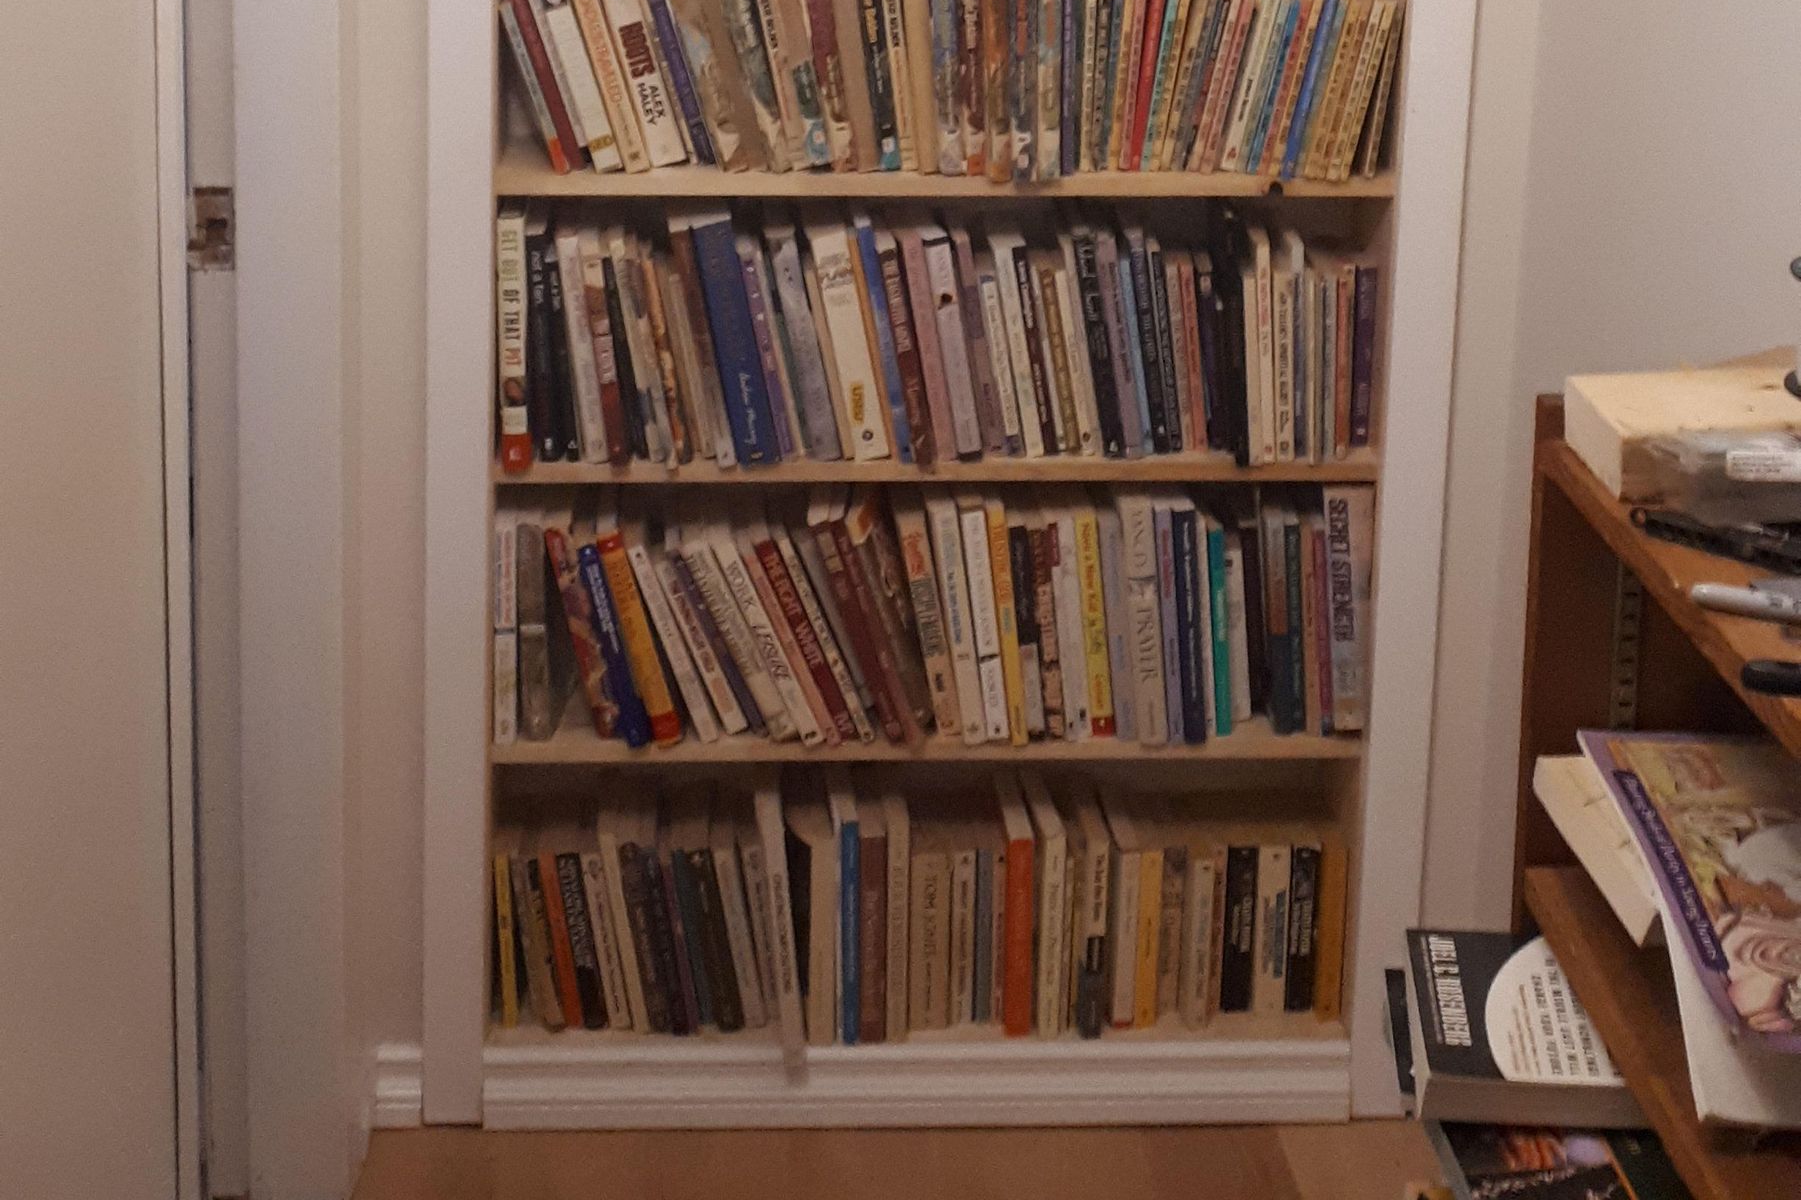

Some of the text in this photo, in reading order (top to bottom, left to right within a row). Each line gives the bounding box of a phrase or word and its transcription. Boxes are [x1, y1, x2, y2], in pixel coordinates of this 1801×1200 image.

[618, 19, 657, 80] ROOTS
[635, 81, 658, 128] HALEY
[647, 83, 666, 120] ALEX
[530, 250, 542, 271] not
[501, 229, 520, 366] GET OUT OF THAT PIT
[533, 284, 544, 305] fan
[1327, 498, 1355, 642] SECRET STRENGTH
[725, 558, 792, 687] WORK LEISURE
[1132, 606, 1162, 683] PRAYER
[1428, 934, 1458, 964] JOEL
[1435, 978, 1472, 1046] ROSENBERG
